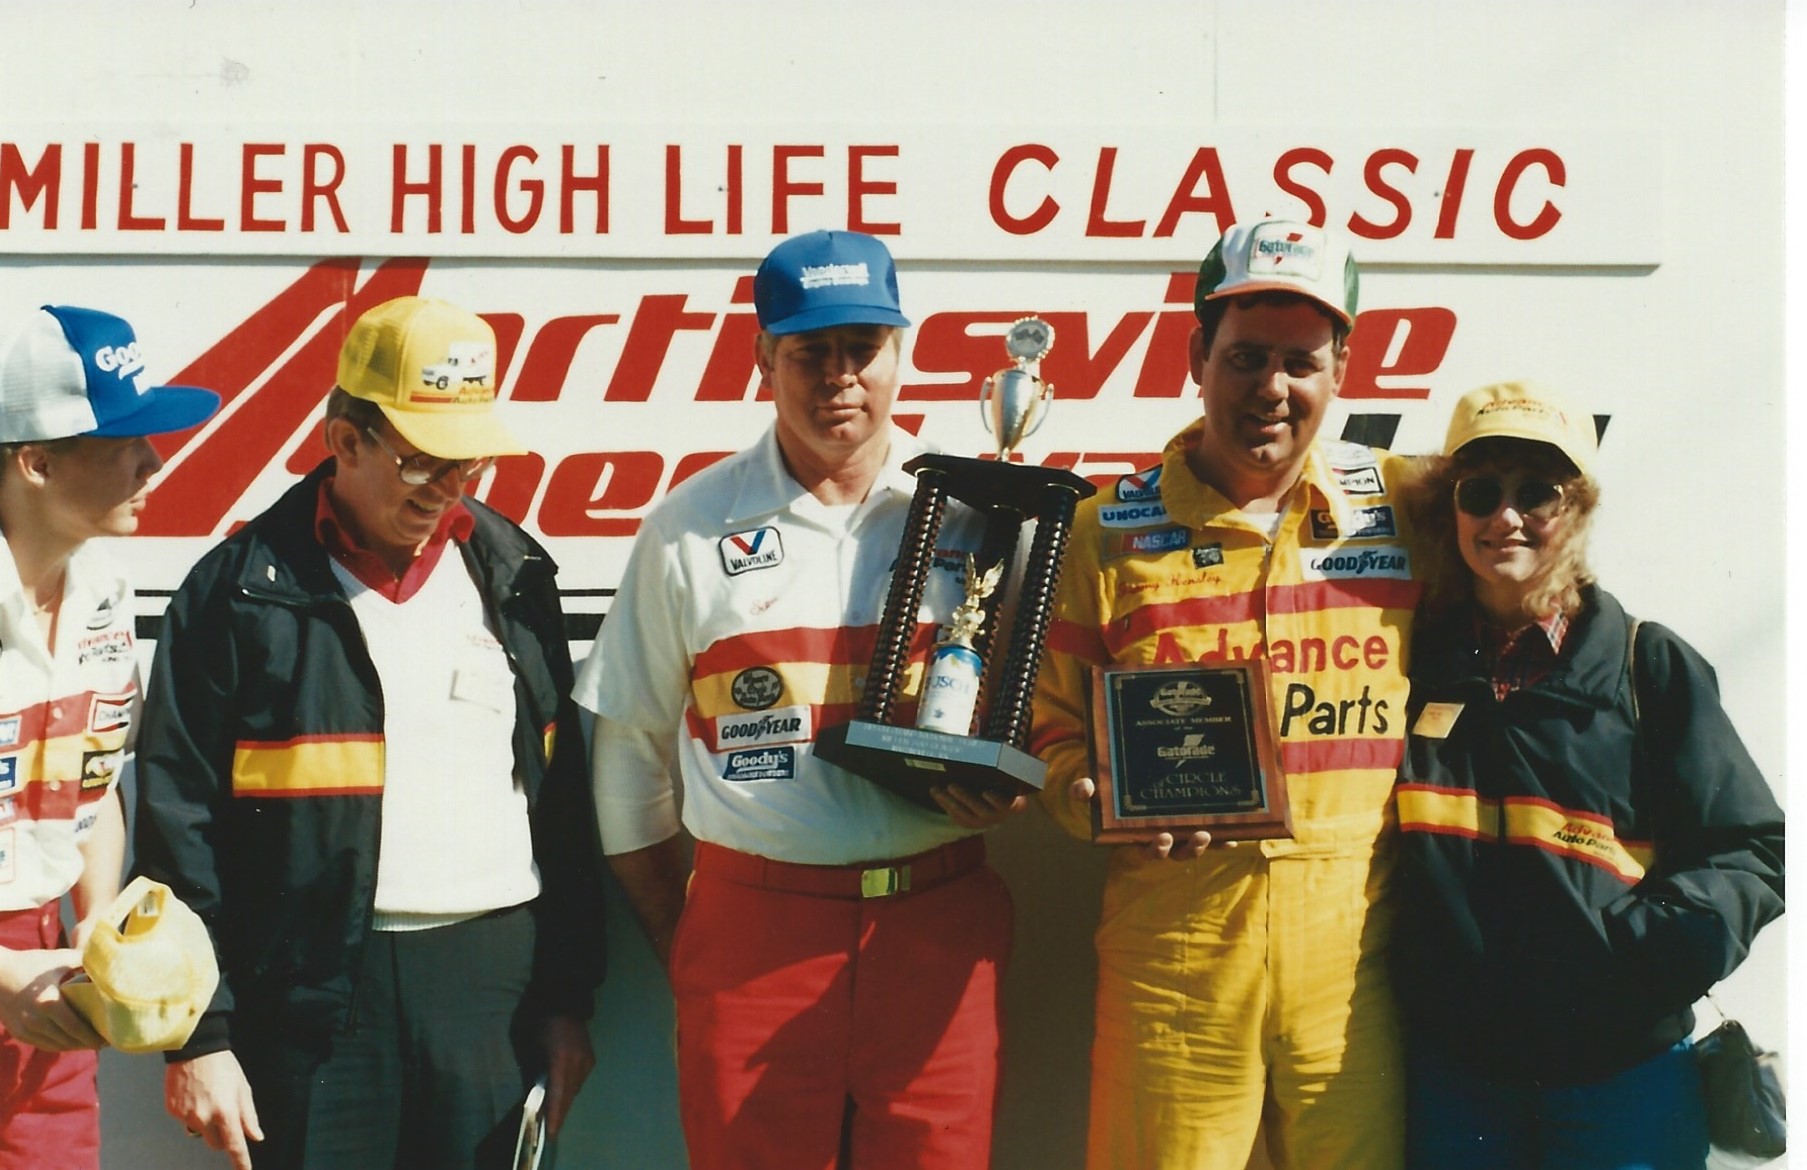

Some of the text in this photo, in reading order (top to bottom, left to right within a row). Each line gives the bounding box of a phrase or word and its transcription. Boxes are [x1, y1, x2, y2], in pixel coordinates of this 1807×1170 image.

[0, 143, 1568, 240] MILLER HIGH LIFE CLASSIC
[1102, 506, 1167, 521] UNOCA
[1132, 530, 1186, 550] NASCAR
[729, 550, 778, 571] VALVOLINE
[1310, 550, 1406, 575] GOODYEAR
[1279, 682, 1388, 738] Parts
[721, 714, 802, 741] GOODYEAR
[732, 750, 788, 770] Goody's
[1157, 744, 1216, 758] Gatorade
